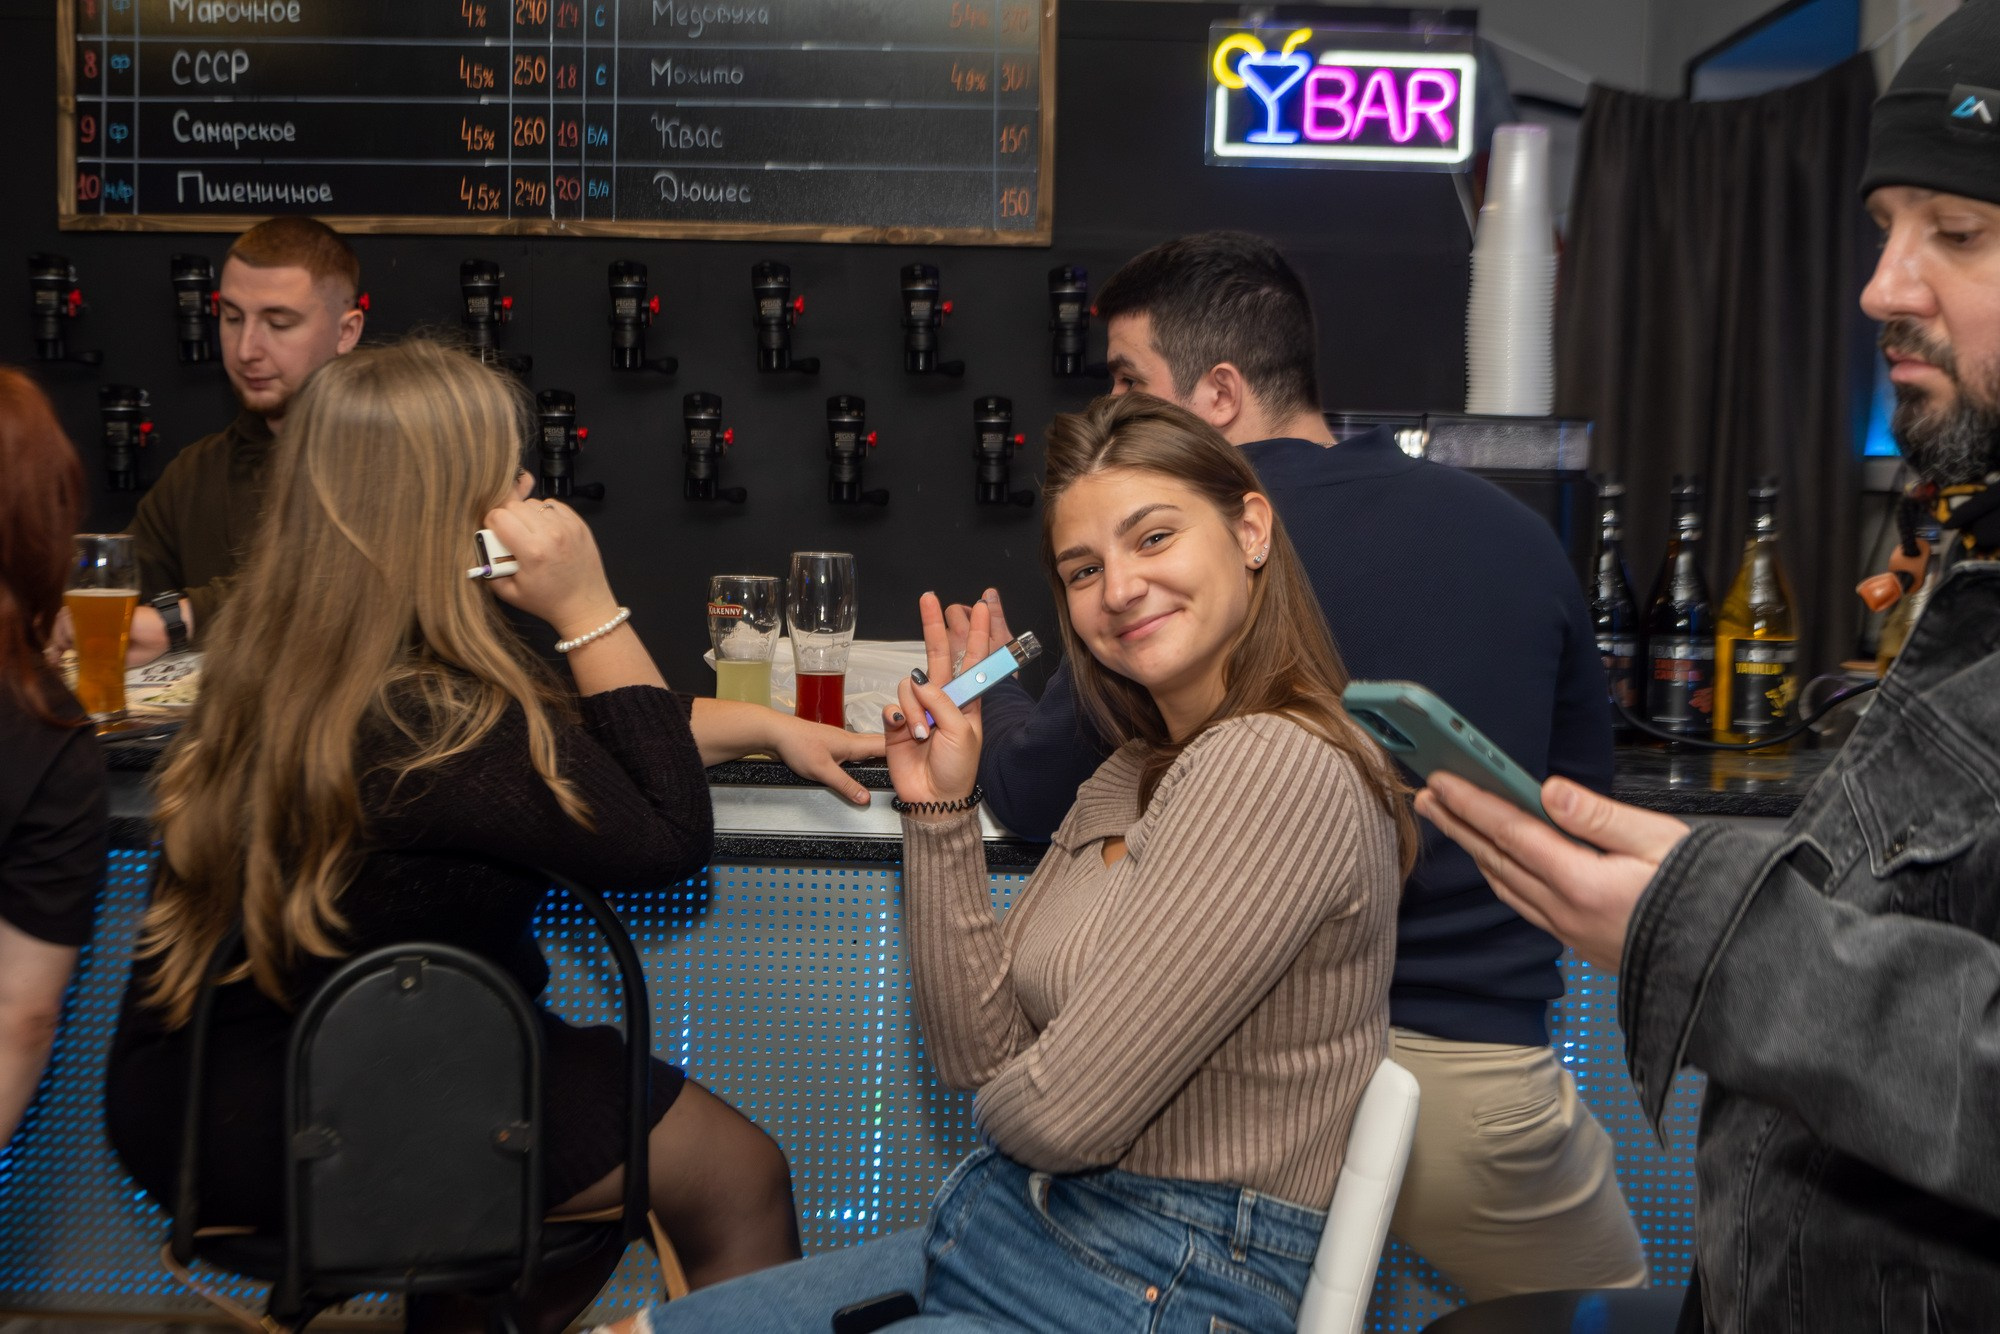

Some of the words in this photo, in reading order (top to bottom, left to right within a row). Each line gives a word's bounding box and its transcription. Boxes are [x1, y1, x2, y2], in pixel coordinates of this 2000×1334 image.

[170, 0, 300, 24] Марочное
[652, 0, 769, 38] Медовуха
[84, 50, 98, 79] 8
[172, 49, 250, 86] СССР
[513, 54, 547, 86] 250
[556, 63, 578, 90] 18
[651, 57, 744, 87] Мохито
[1303, 65, 1458, 143] BAR
[80, 115, 96, 143] 9
[173, 109, 296, 150] Самарское
[513, 115, 546, 147] 260
[557, 120, 579, 148] 19
[651, 113, 723, 149] Квас
[1000, 125, 1030, 154] 150
[77, 173, 99, 200] 10
[177, 171, 333, 203] Пшеничное
[555, 175, 581, 201] 20
[653, 171, 751, 203] Дюшес
[1000, 189, 1030, 217] 150
[708, 606, 741, 616] KILKENNY
